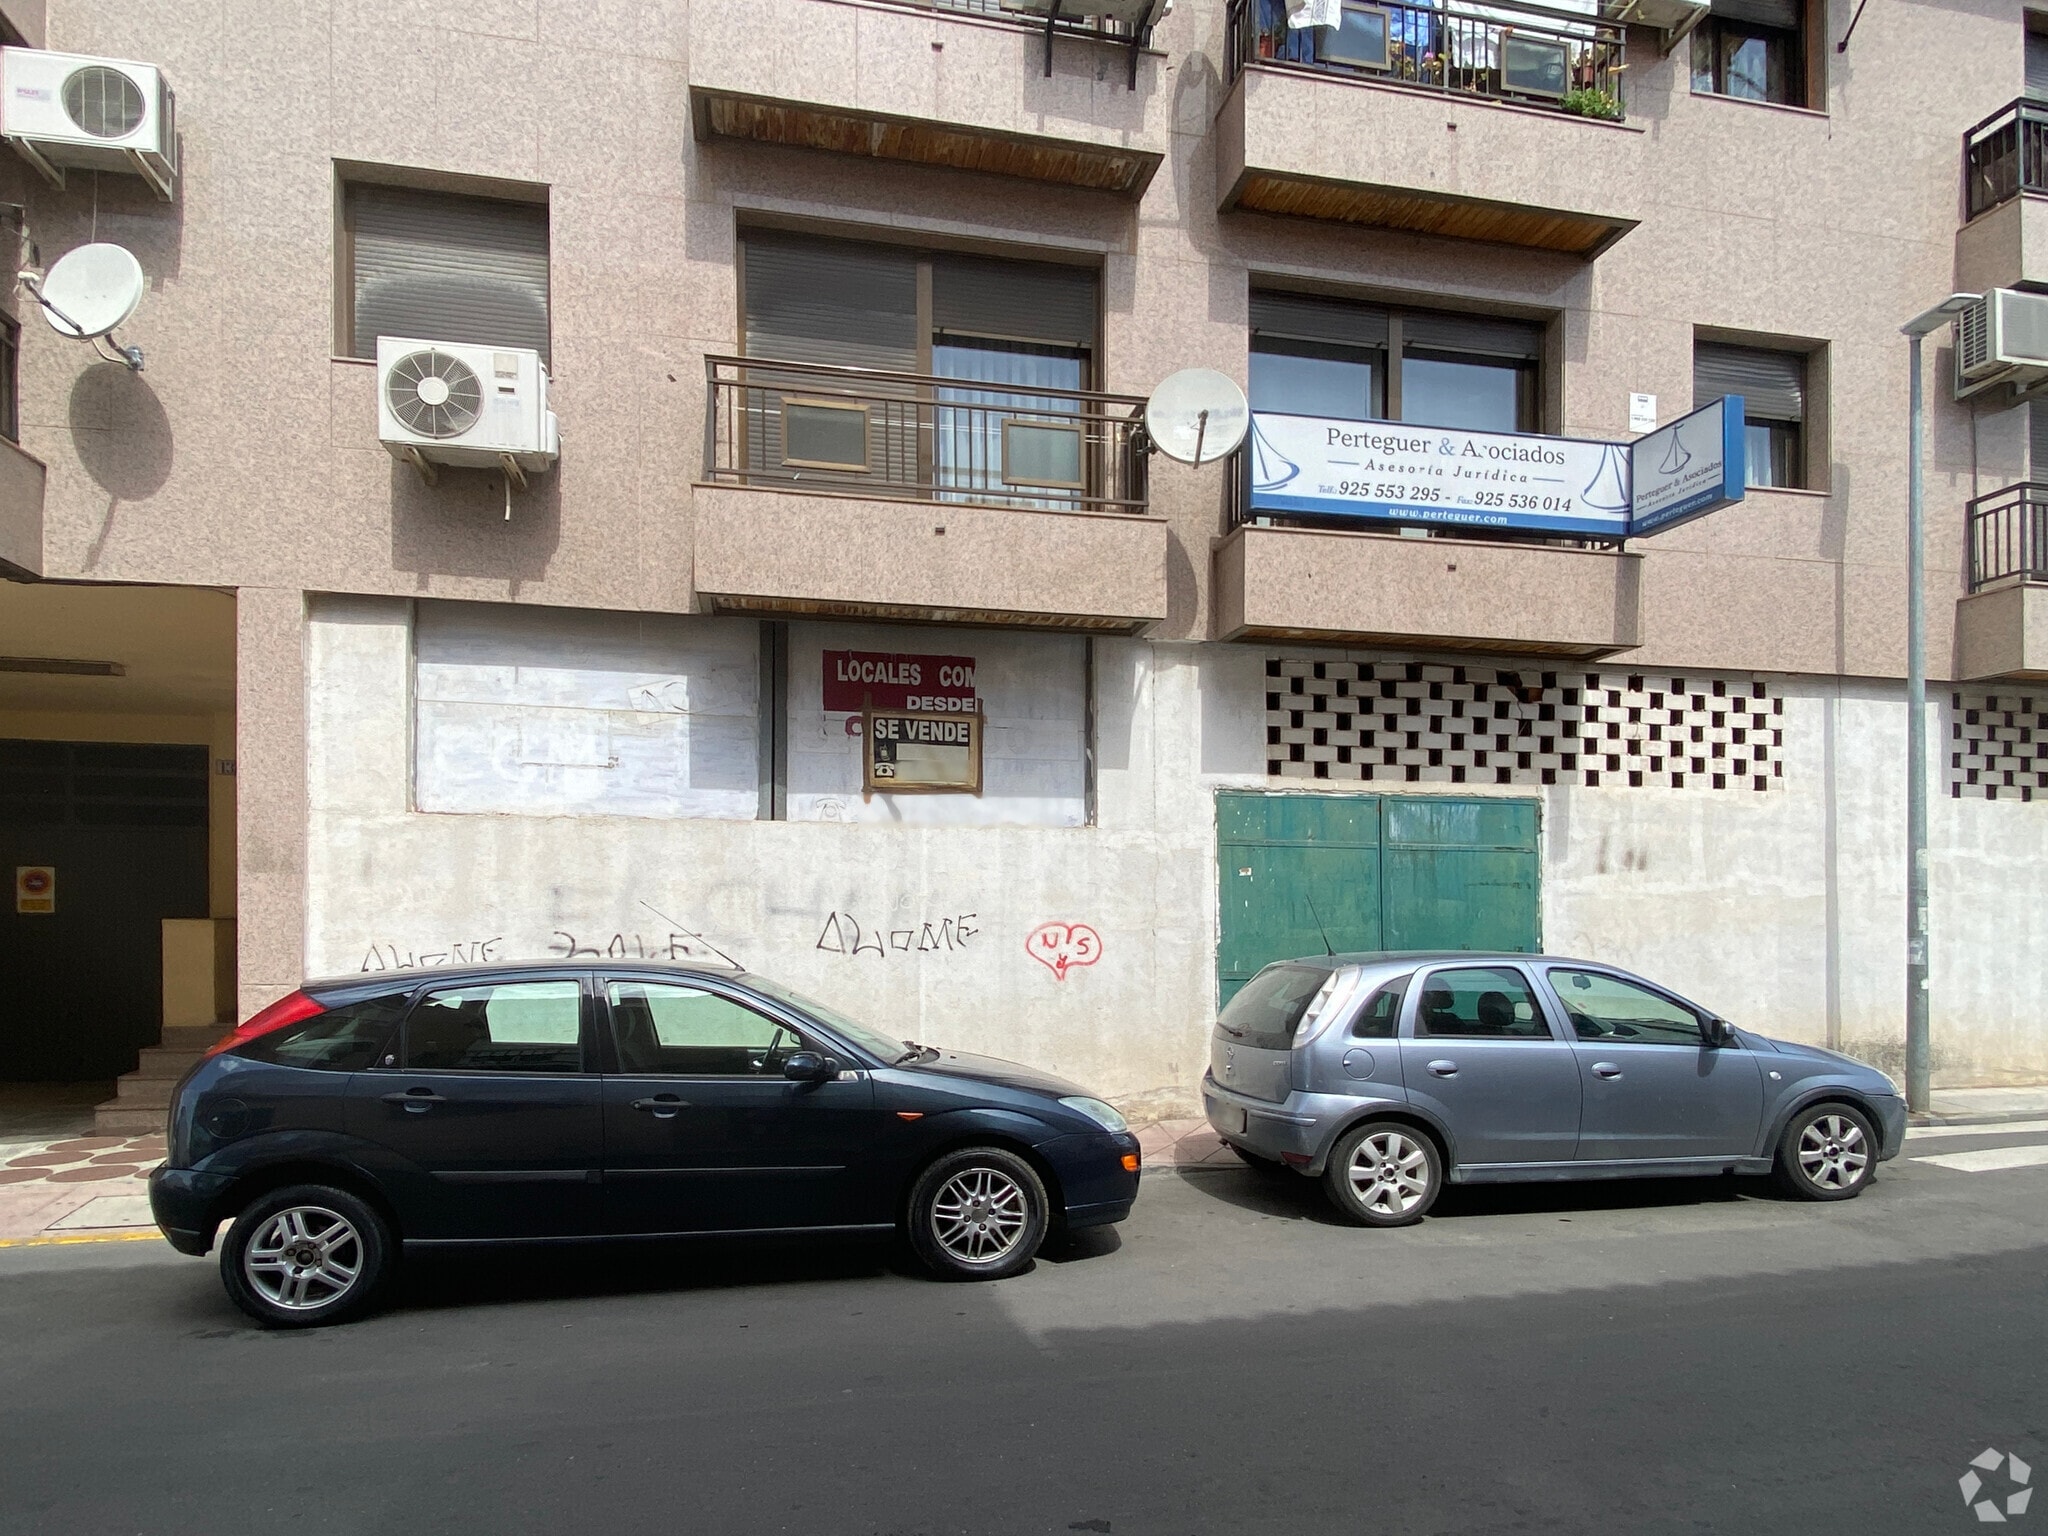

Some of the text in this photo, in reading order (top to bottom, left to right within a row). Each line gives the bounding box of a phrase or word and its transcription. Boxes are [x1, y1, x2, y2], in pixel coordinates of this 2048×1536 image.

[1327, 427, 1565, 465] Perteguer & Aociados
[1364, 459, 1528, 482] Asesoría Jurídica
[1339, 481, 1370, 496] 925
[1374, 484, 1405, 499] 553
[1410, 486, 1441, 502] 295
[1474, 491, 1504, 506] 925
[1508, 494, 1538, 509] 536
[1542, 496, 1572, 512] 014
[1388, 508, 1508, 524] www.perteguer.com
[837, 659, 922, 686] LOCALES
[906, 695, 975, 712] DESDE
[875, 719, 969, 743] SE VENDE
